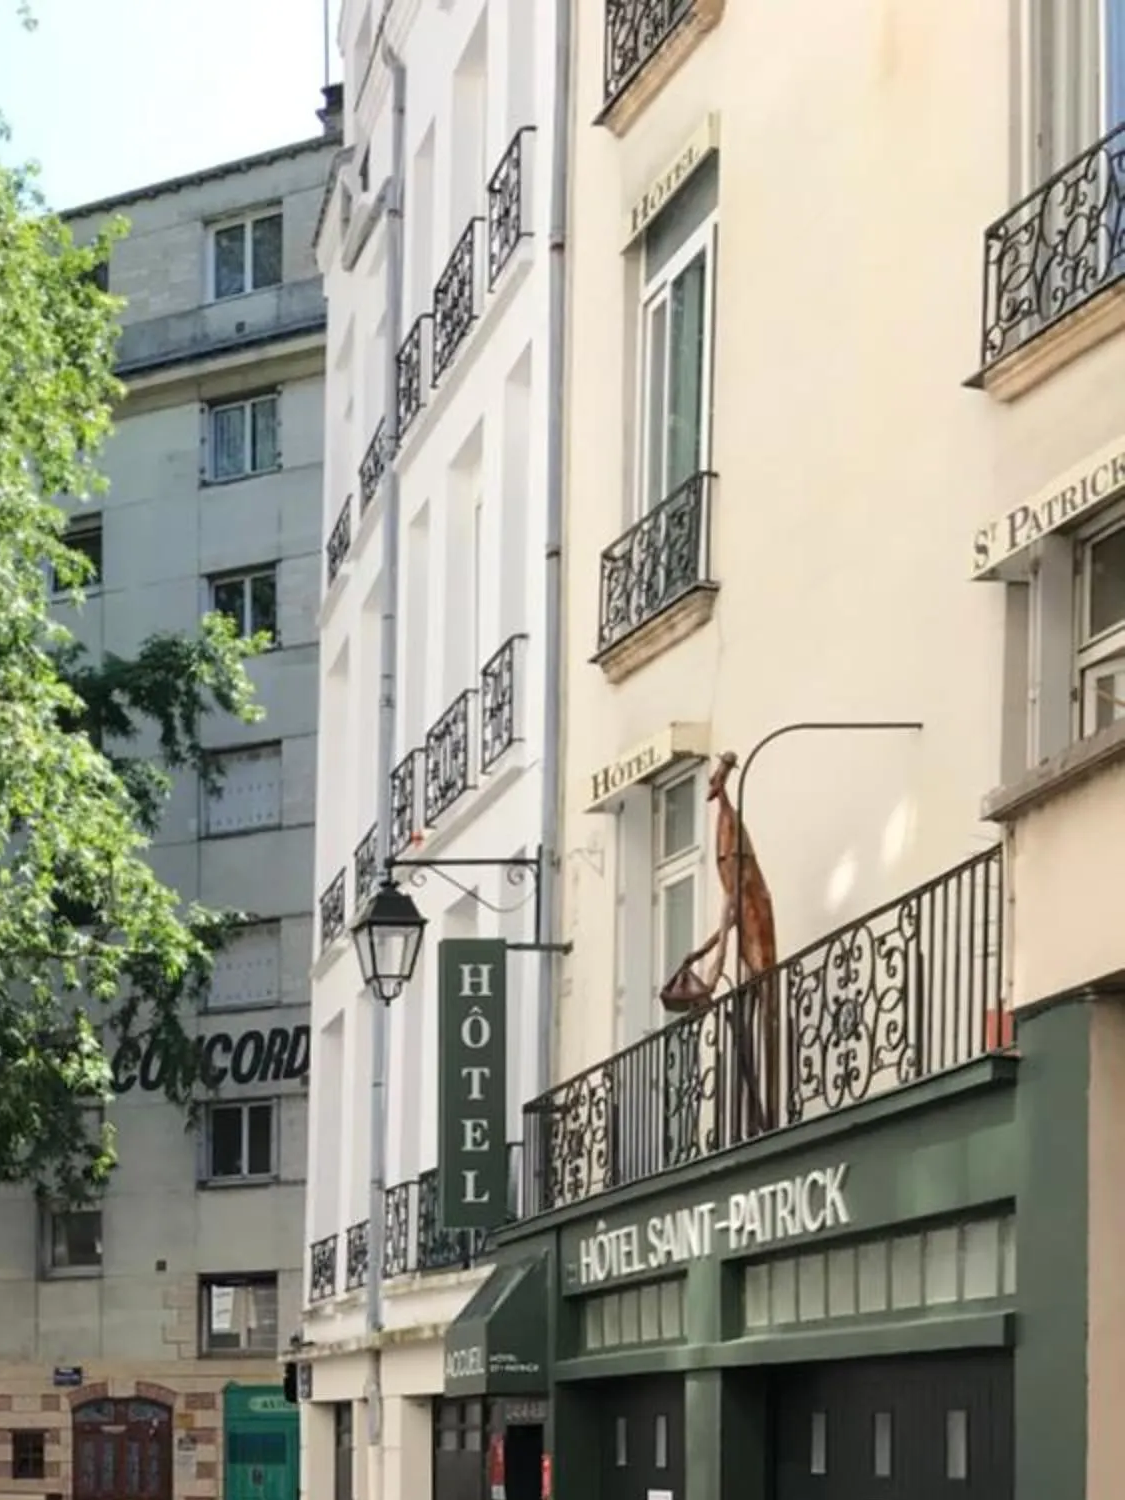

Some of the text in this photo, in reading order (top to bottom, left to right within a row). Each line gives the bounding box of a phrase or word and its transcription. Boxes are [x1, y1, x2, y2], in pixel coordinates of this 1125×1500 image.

[1005, 452, 1125, 553] PATRICK
[111, 1024, 311, 1094] COCORD
[458, 962, 494, 1204] HÔTEL
[580, 1218, 646, 1286] HÔTEL
